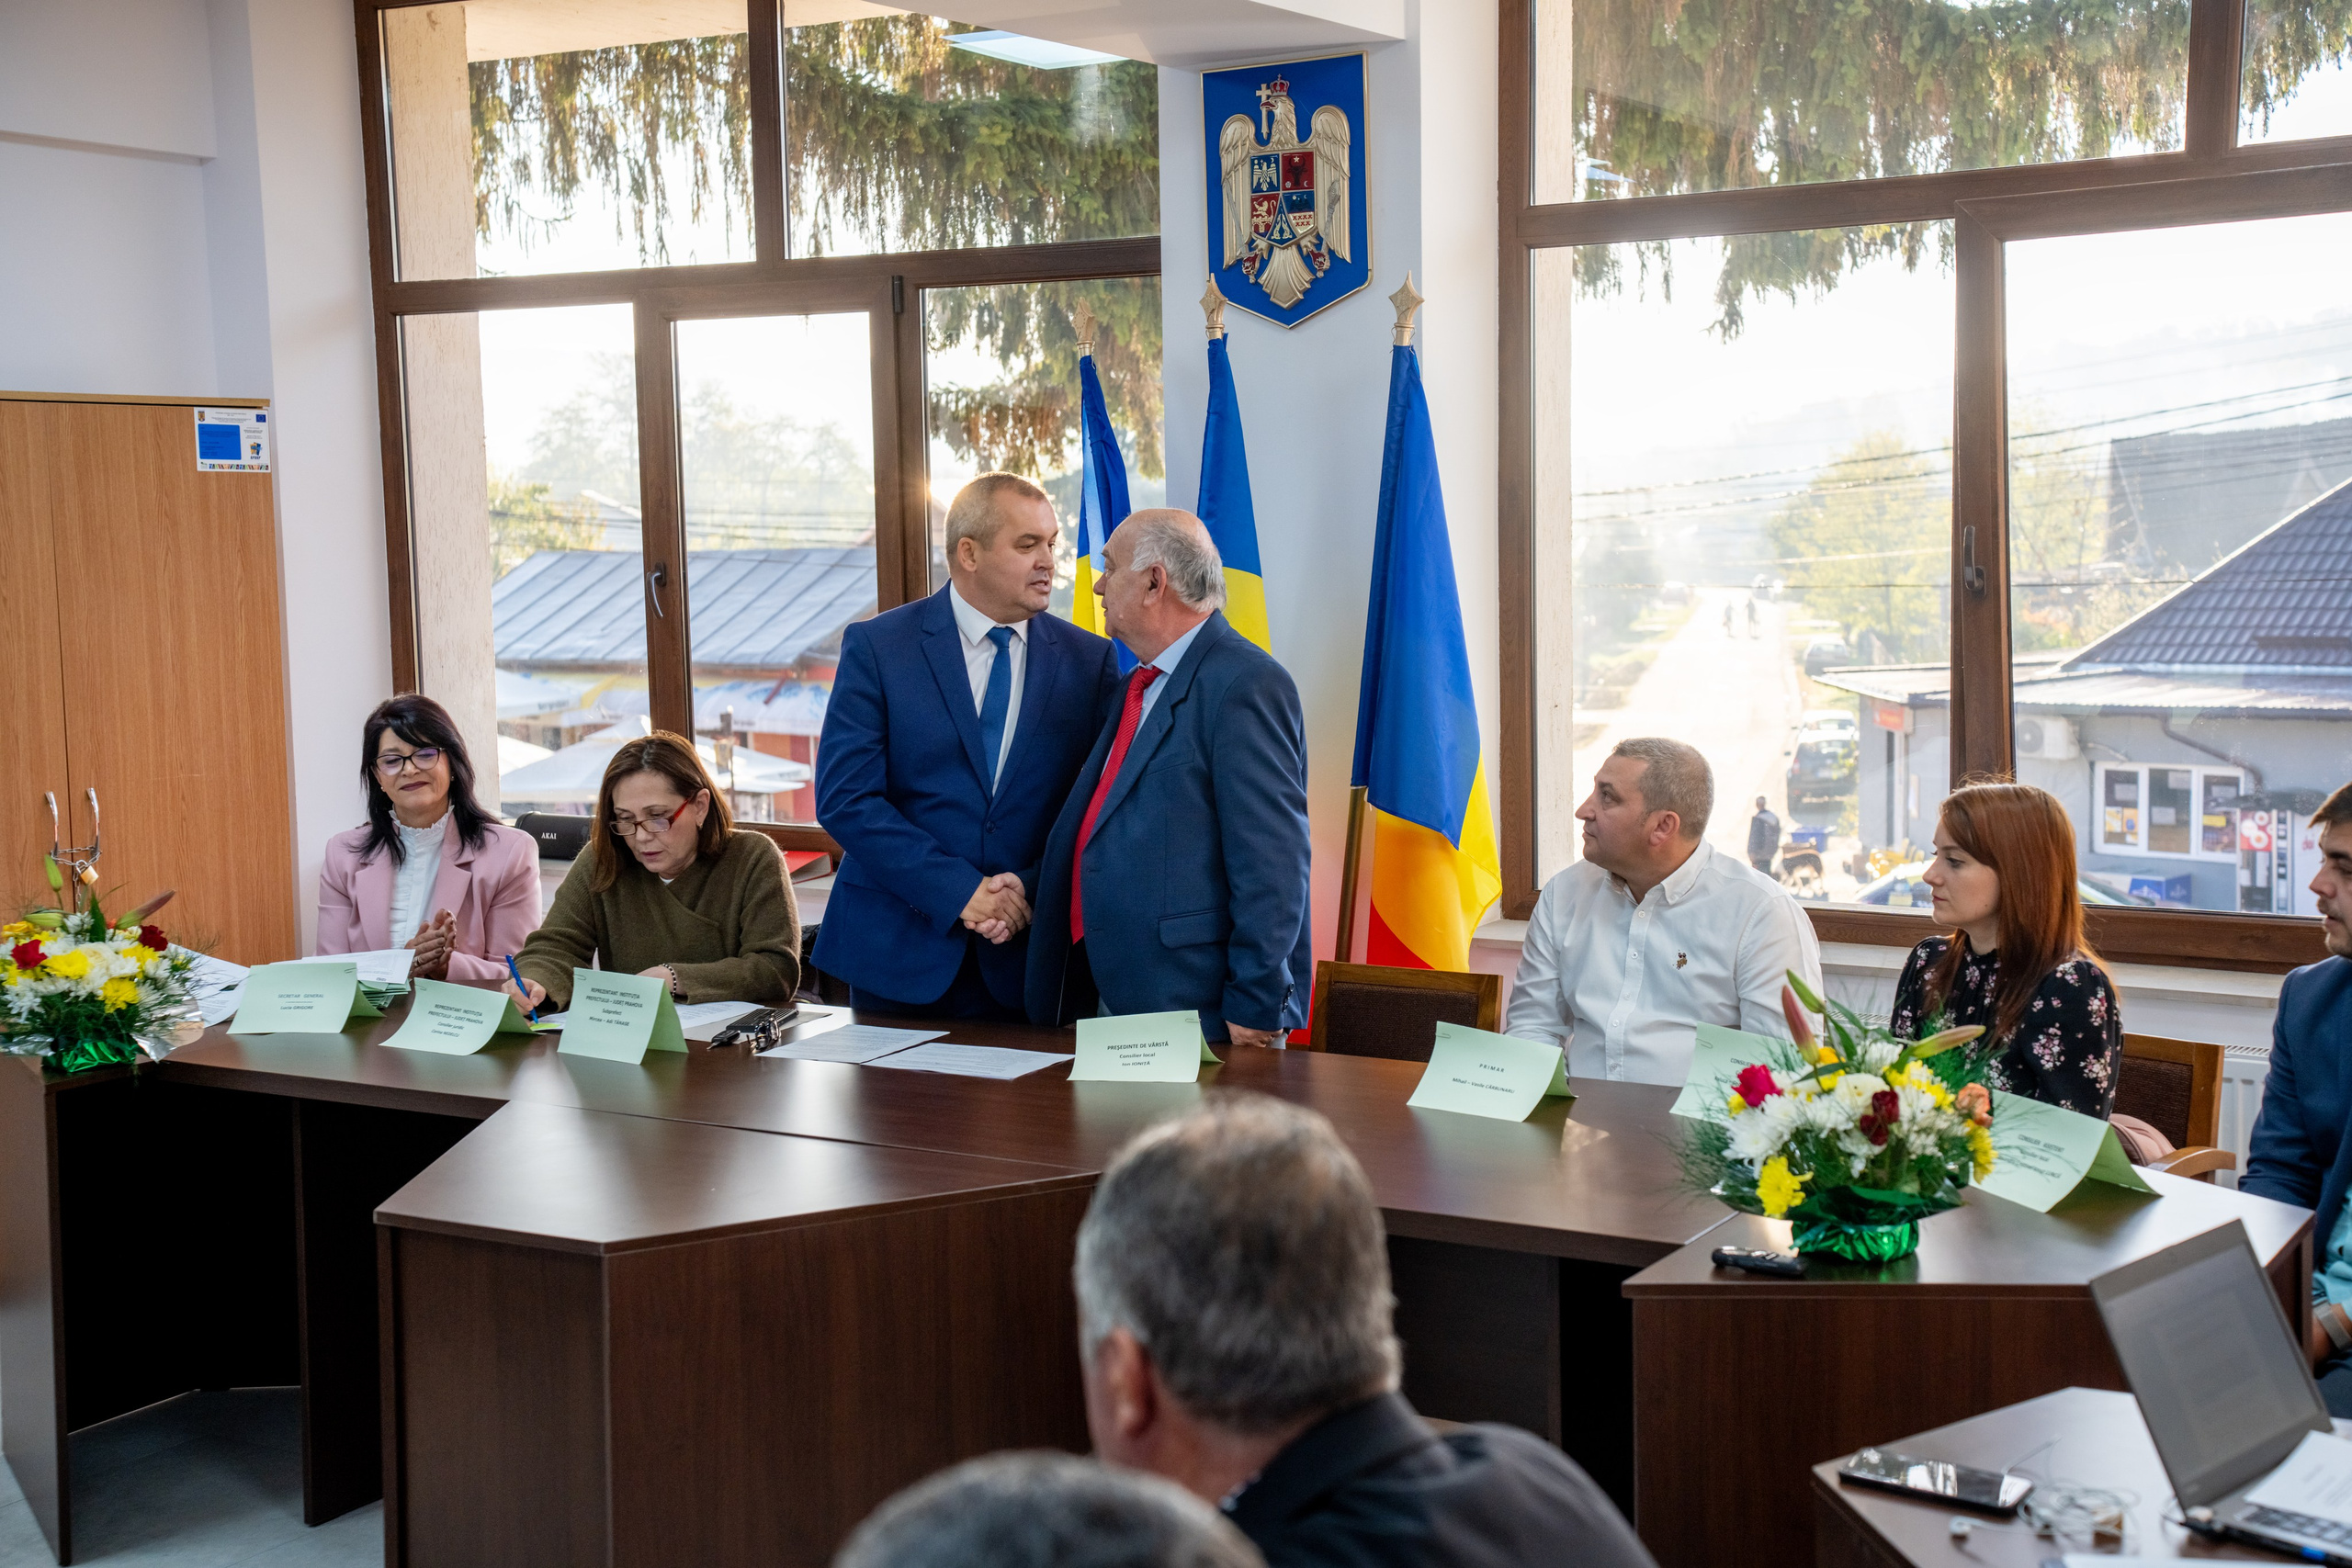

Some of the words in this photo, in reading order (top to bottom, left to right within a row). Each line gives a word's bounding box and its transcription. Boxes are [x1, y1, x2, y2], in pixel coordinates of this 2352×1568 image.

[591, 987, 618, 996] REPREZENTANT
[435, 1004, 462, 1012] REPREZENTANT
[1479, 1063, 1504, 1073] PRIMAR
